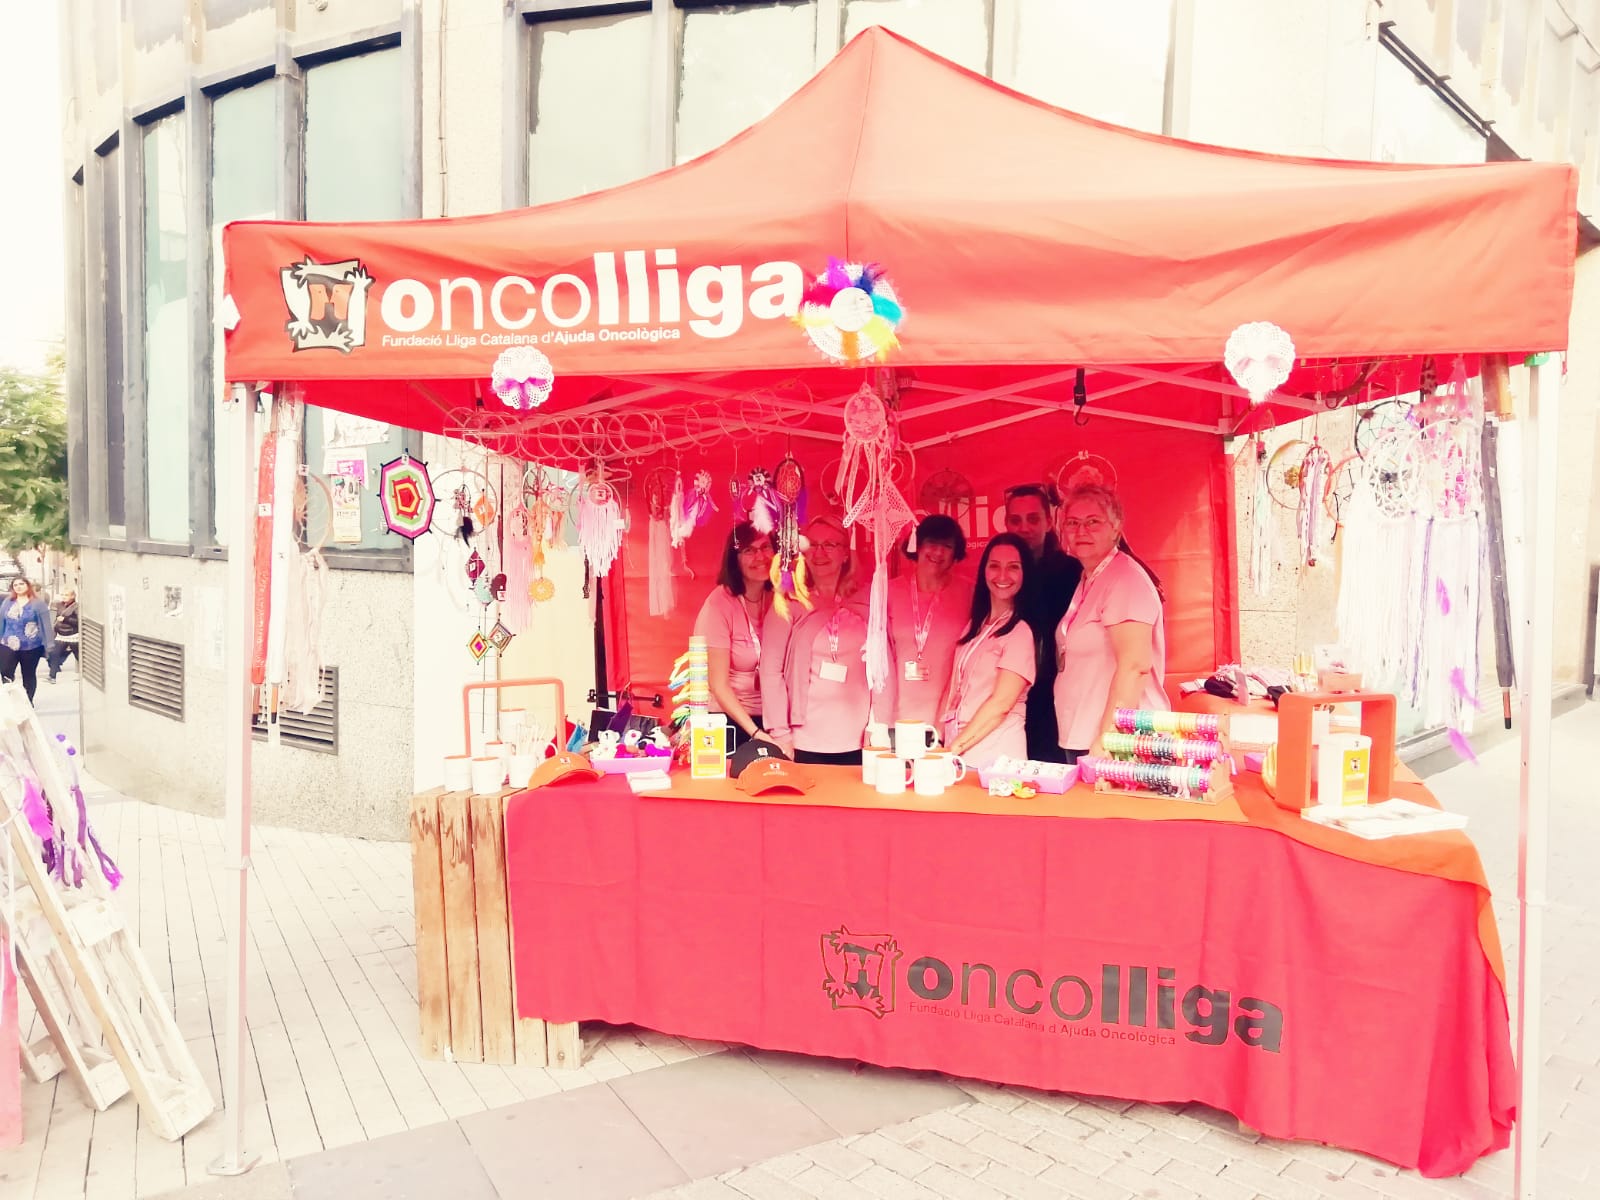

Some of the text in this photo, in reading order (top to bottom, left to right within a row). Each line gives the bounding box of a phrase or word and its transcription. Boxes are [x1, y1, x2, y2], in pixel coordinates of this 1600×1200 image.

[381, 248, 804, 338] oncolliga
[381, 326, 681, 348] Fundació Lliga Catalana d'Ajuda Oncològica
[907, 957, 1283, 1054] oncolliga
[964, 1009, 991, 1024] Lliga
[994, 1013, 1045, 1033] Catalana
